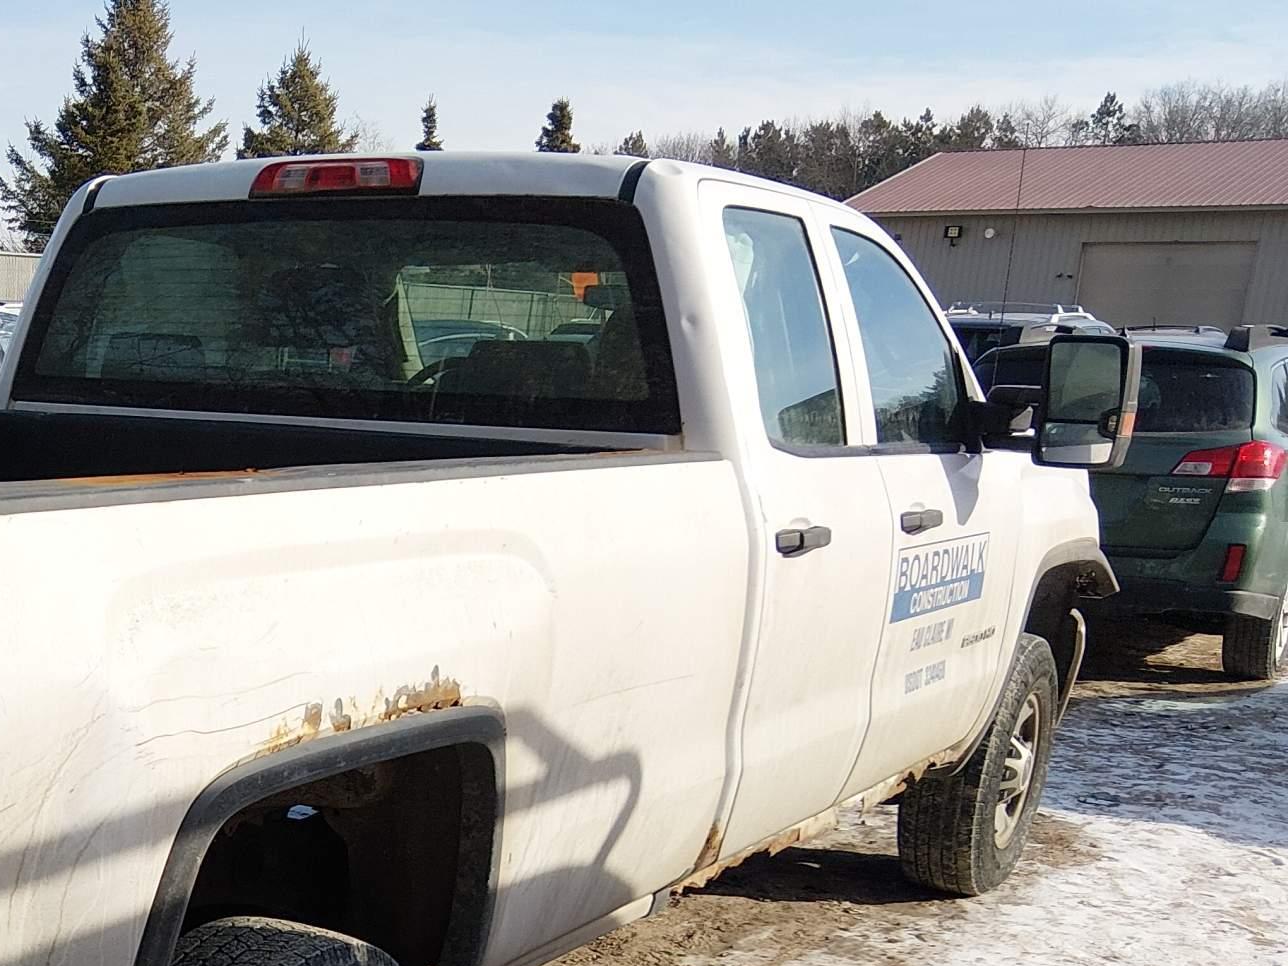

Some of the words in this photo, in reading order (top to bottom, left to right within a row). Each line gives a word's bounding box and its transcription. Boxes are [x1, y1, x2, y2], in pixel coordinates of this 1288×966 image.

[1158, 486, 1214, 494] OUTBACK
[899, 540, 987, 591] BOARDWALK
[909, 580, 971, 614] CONSTRUCTION
